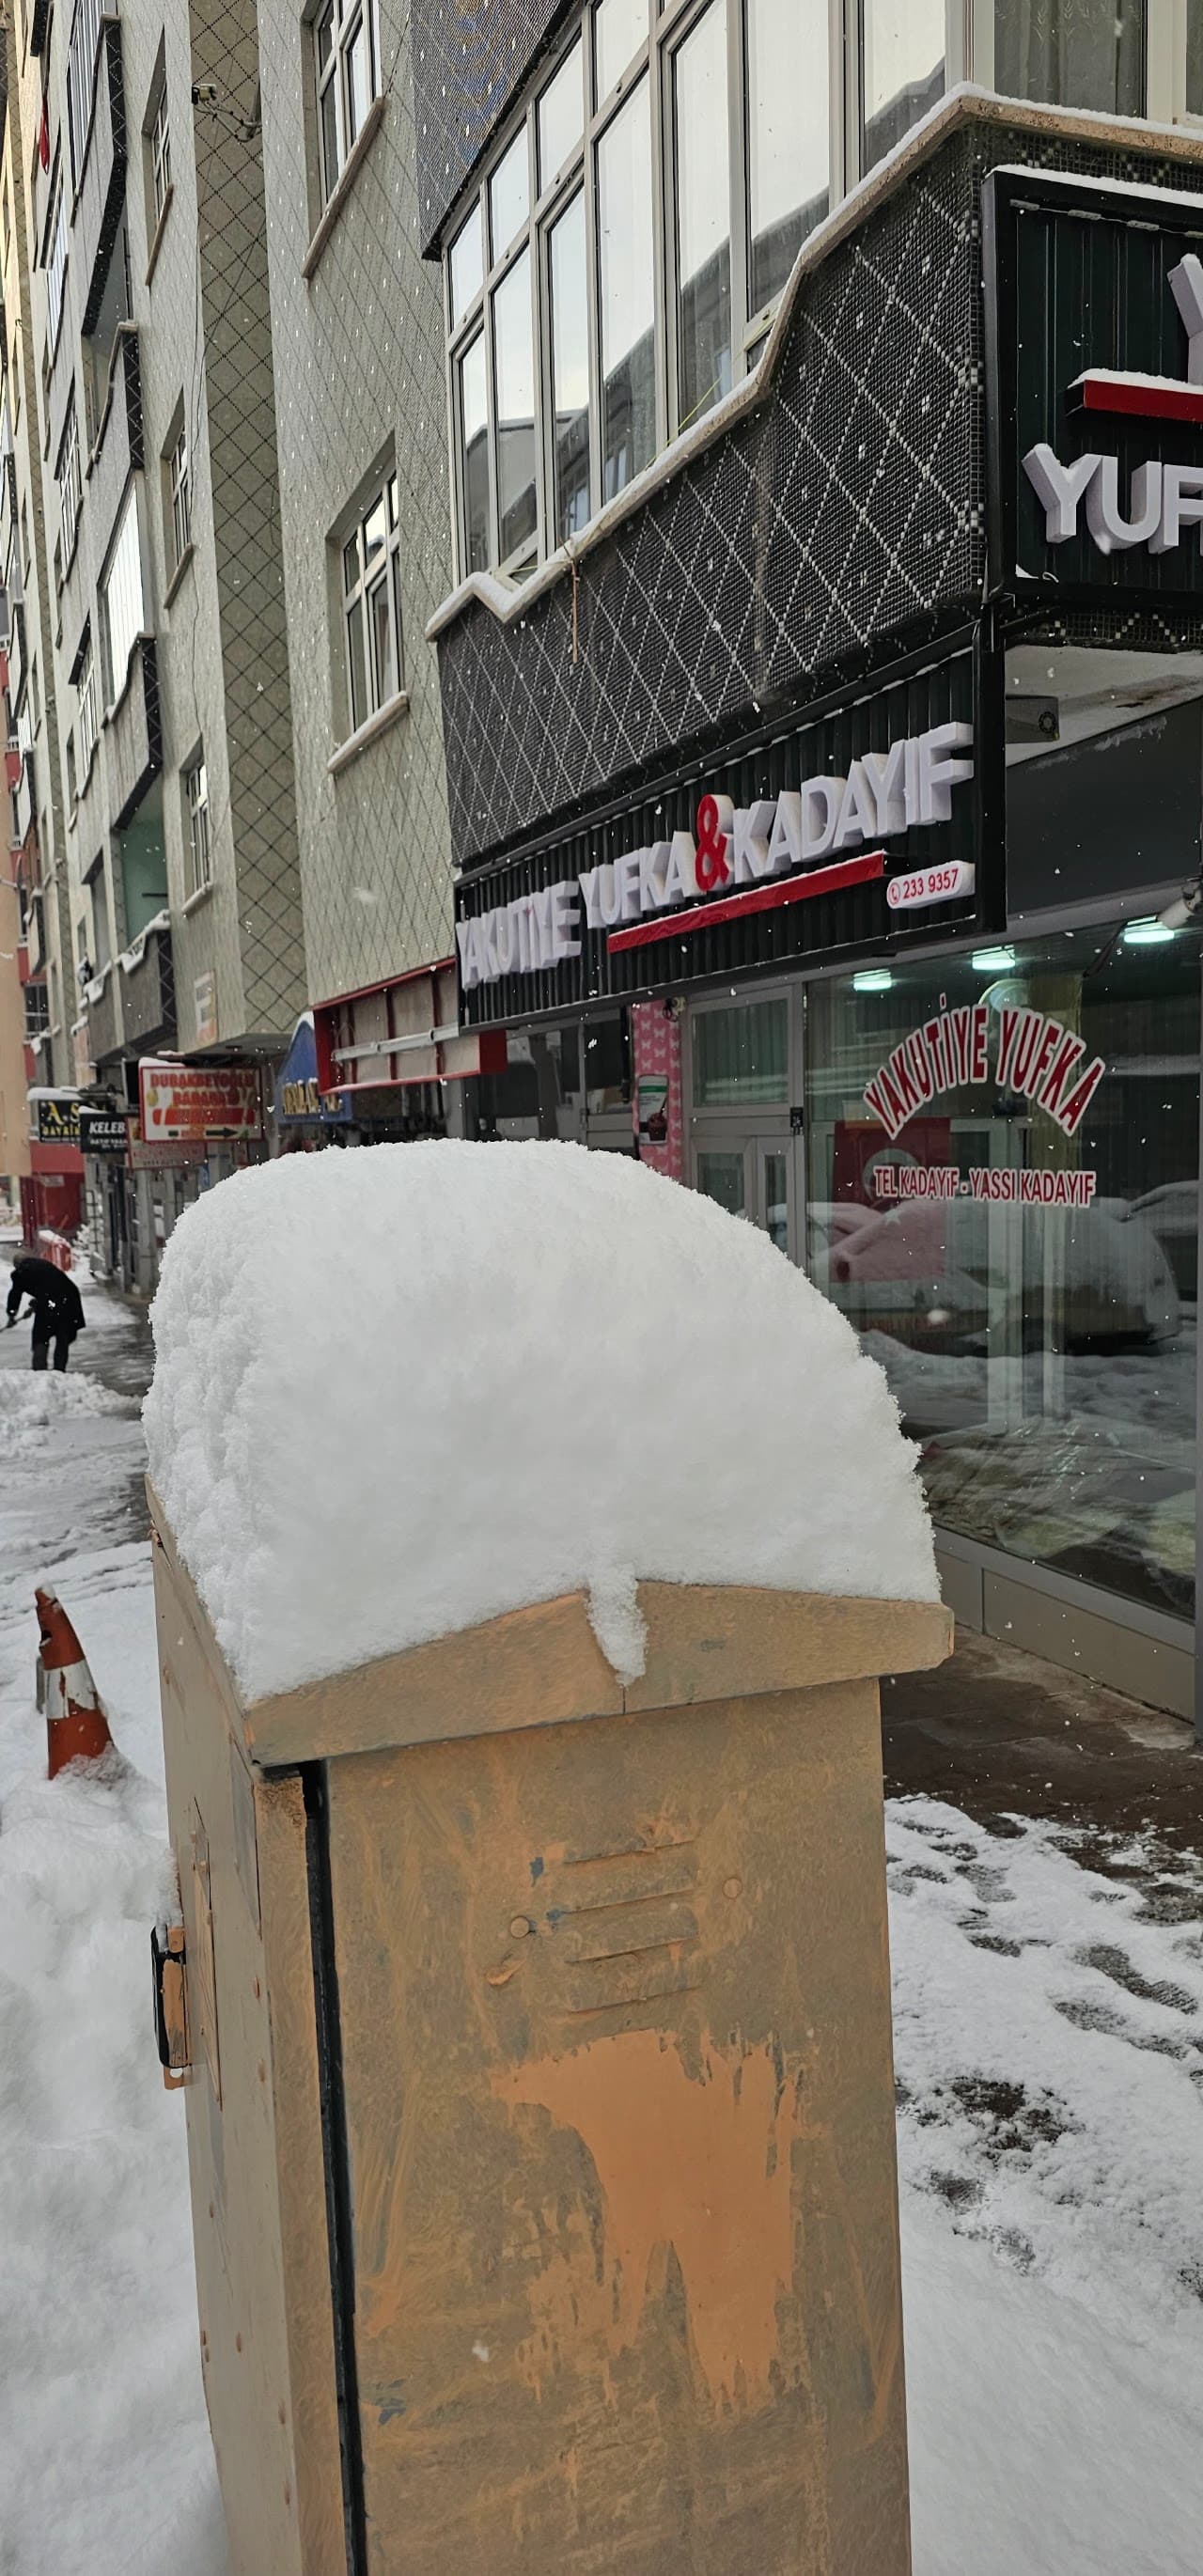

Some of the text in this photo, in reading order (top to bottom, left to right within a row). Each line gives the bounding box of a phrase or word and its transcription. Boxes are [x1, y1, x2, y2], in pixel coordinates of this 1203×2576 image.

[1021, 443, 1203, 555] YUF
[578, 831, 707, 929] YUFKA
[733, 722, 974, 883] KADAYIF
[903, 868, 959, 899] 233 9357
[864, 992, 1105, 1140] YAKUTİYE YUFKA
[89, 1120, 125, 1135] KELEB
[873, 1165, 898, 1197] TEL
[969, 1167, 1017, 1203] YASSI
[1019, 1169, 1097, 1209] KADAYIF
